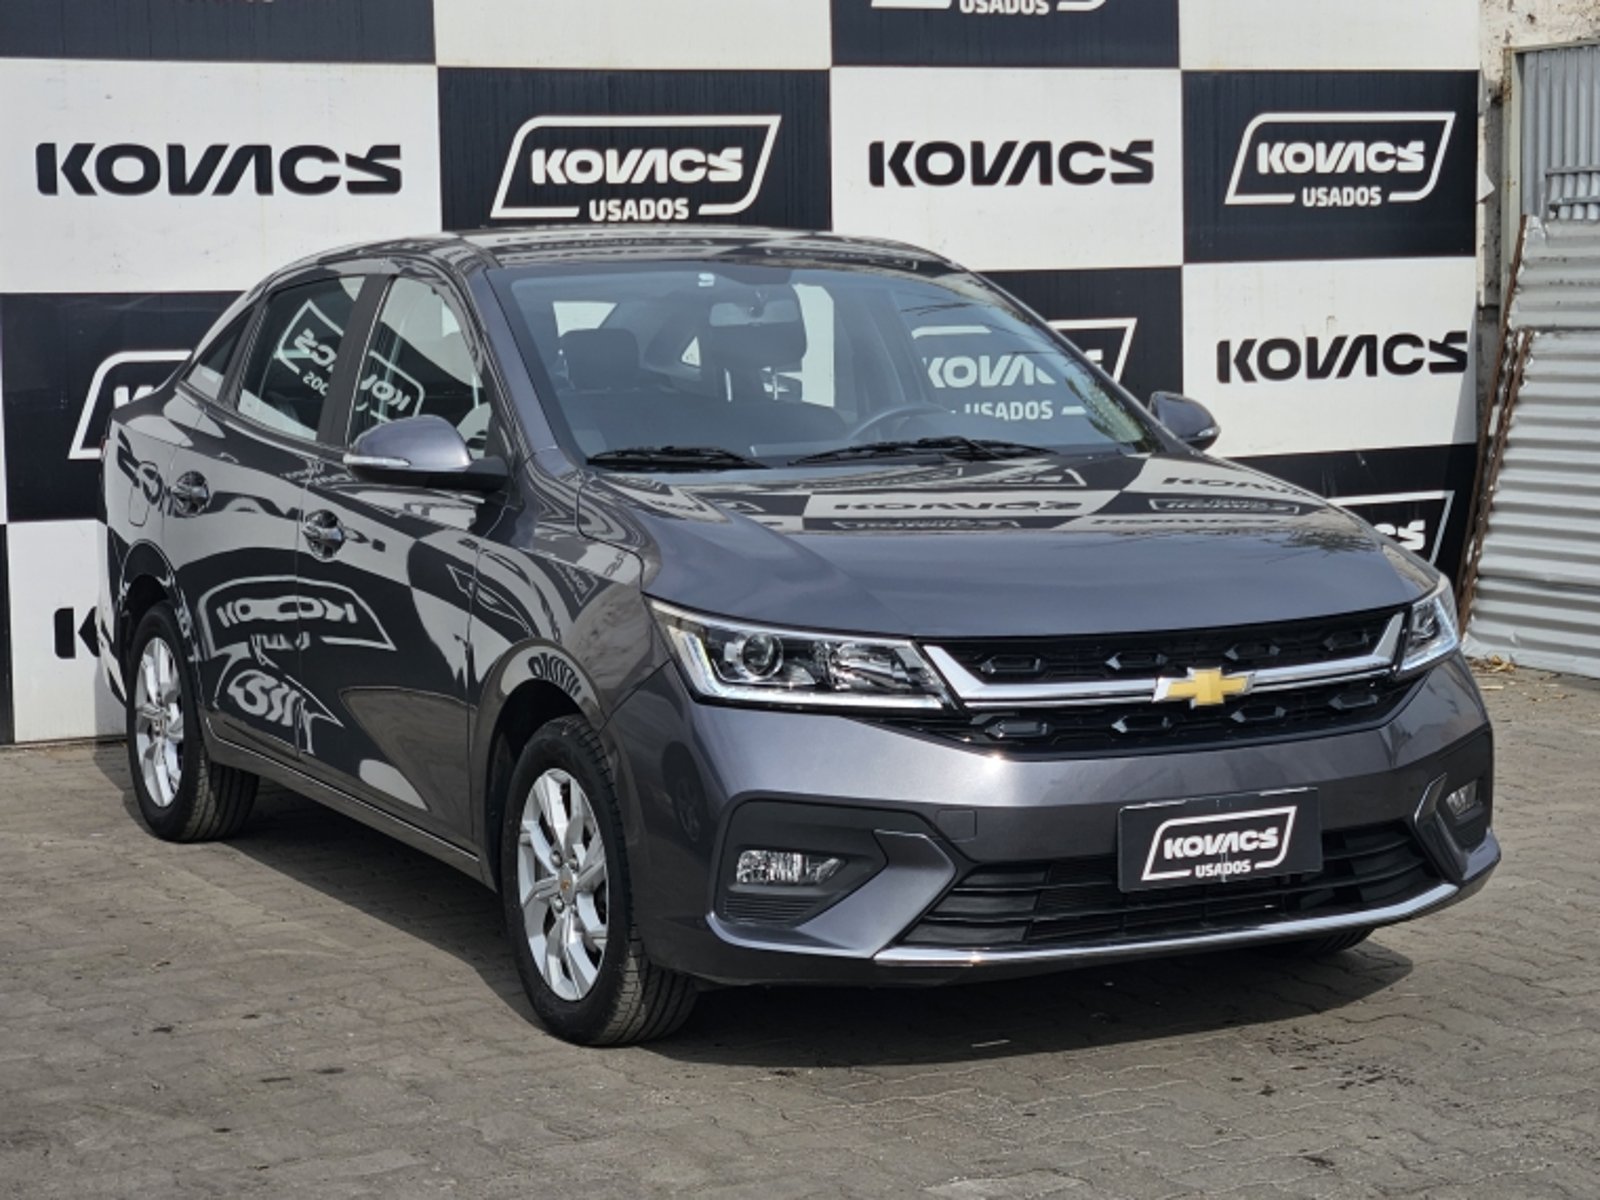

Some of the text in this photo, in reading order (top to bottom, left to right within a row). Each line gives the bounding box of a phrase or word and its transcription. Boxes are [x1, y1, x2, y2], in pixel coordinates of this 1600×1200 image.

[959, 0, 1050, 15] USADOS
[36, 142, 402, 196] KOVACS
[531, 147, 743, 185] KOVACS
[868, 140, 1154, 187] KOVACS
[1257, 140, 1425, 174] KOVACS
[589, 197, 689, 222] USADOS
[1302, 186, 1382, 207] USADOS
[1217, 330, 1469, 384] KOVACS
[1163, 826, 1280, 860] KOVACS
[1195, 859, 1251, 878] USADOS
